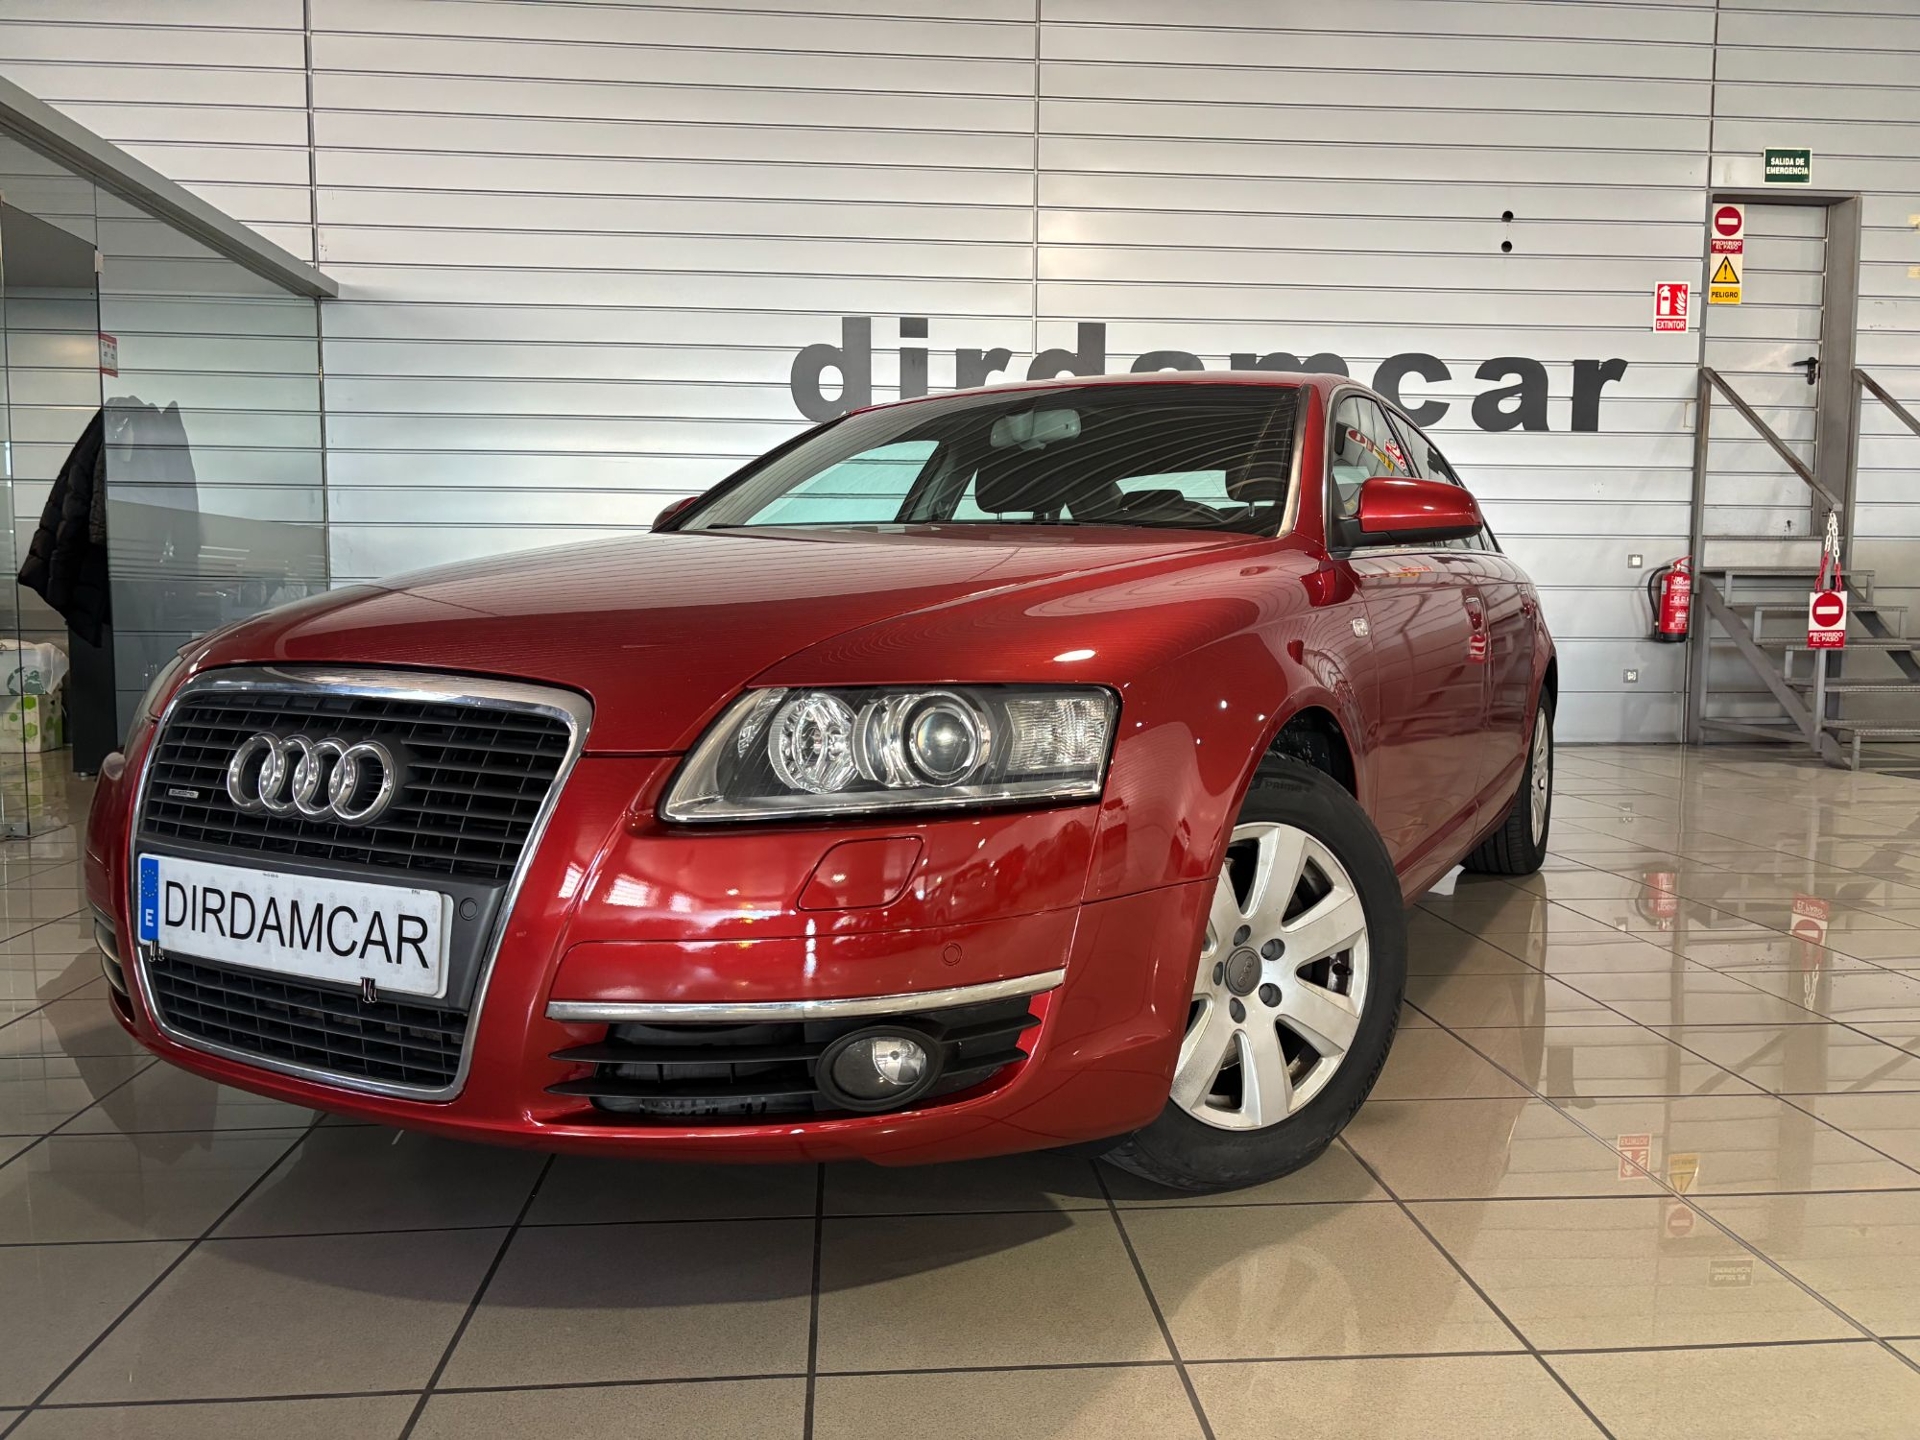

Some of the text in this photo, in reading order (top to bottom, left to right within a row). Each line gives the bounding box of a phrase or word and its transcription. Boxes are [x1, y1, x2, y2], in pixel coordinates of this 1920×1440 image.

[1770, 157, 1805, 166] SALIDA DE
[1766, 166, 1809, 175] EMERGENCIA
[1711, 291, 1739, 299] PELIGRO
[1656, 320, 1686, 330] EXTINTOR
[145, 908, 154, 927] E
[165, 880, 430, 969] DIRDAMCAR
